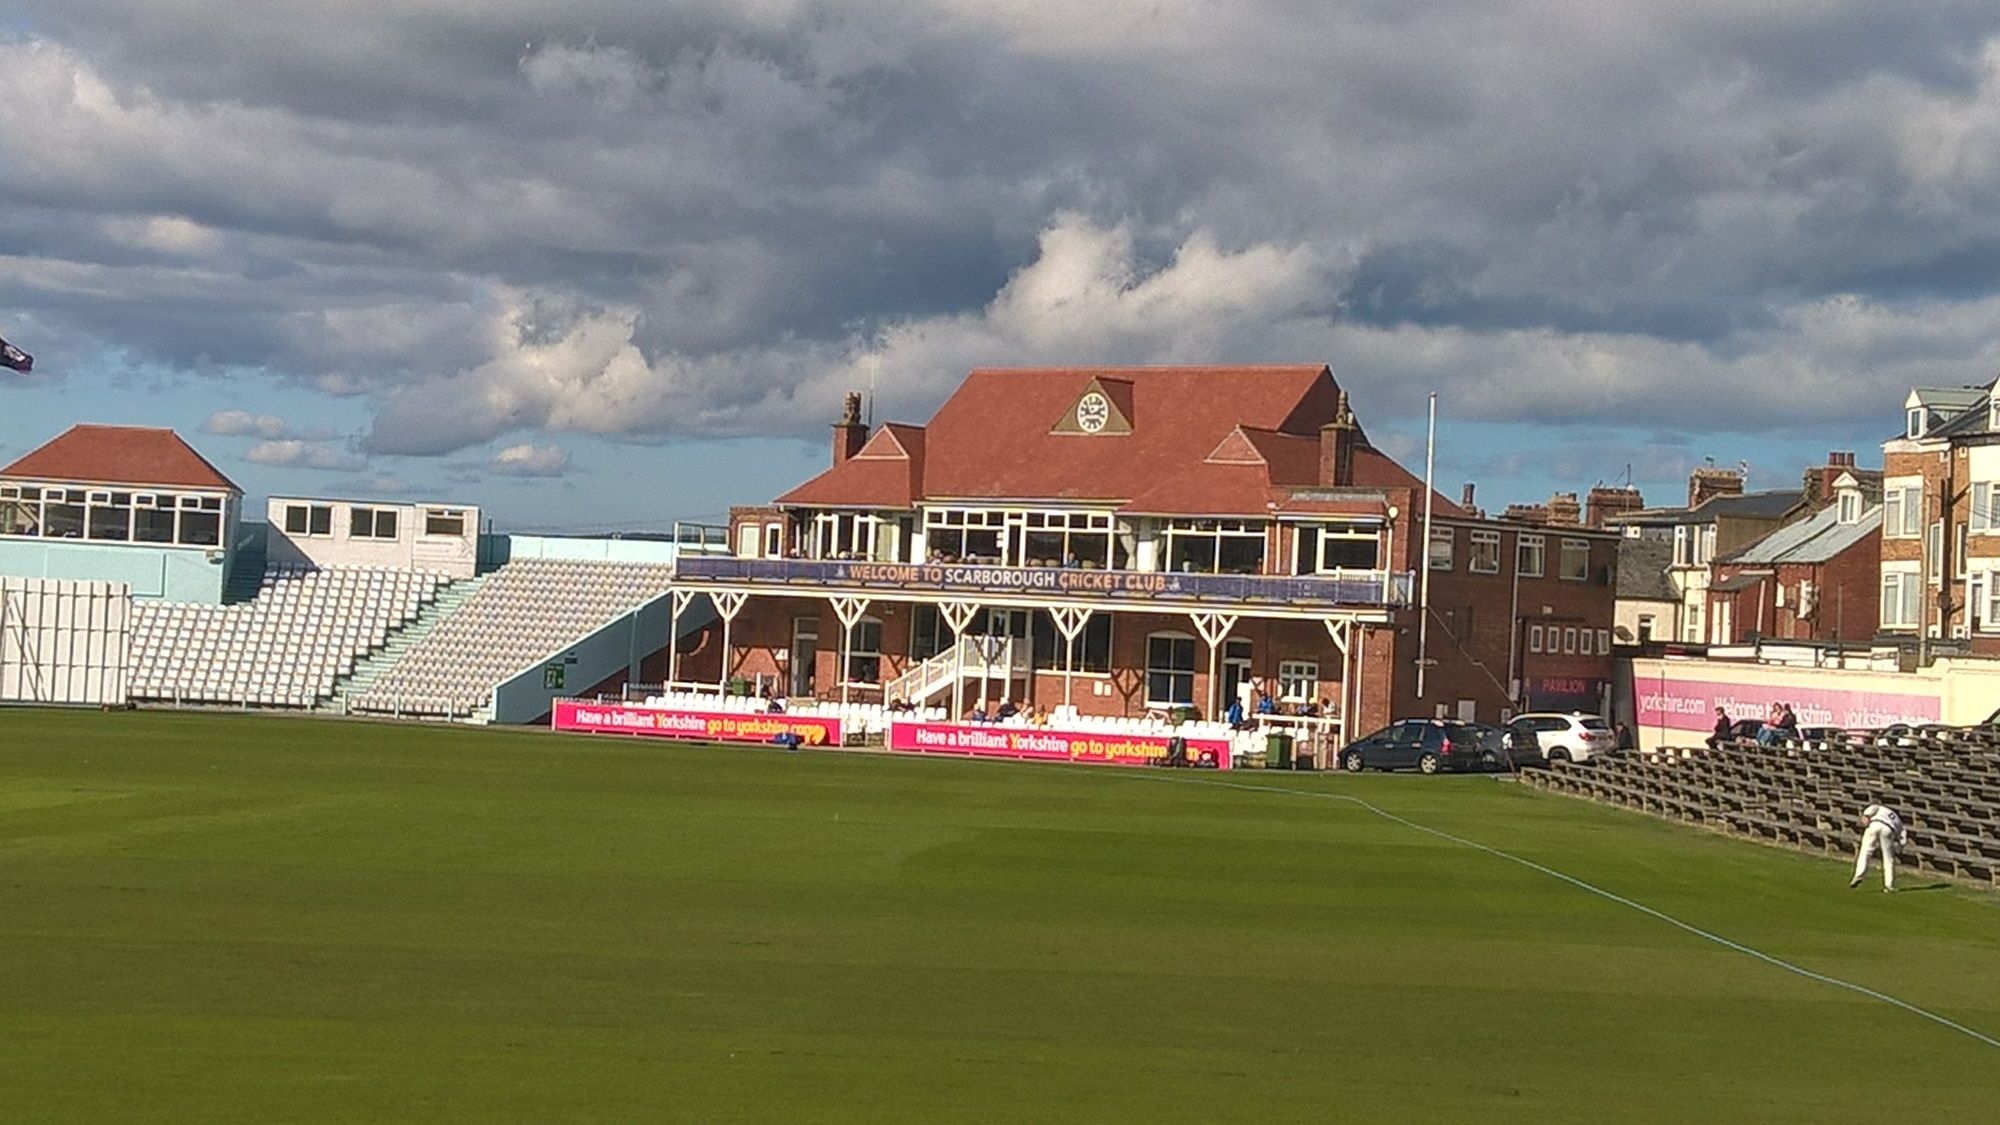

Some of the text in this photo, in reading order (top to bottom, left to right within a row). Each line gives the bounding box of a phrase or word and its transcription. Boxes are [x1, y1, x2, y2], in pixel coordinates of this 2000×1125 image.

[850, 565, 1166, 591] WELCOME TO SCARBOROUGH CRICKET CLUB
[1542, 679, 1586, 693] PAVILION
[1640, 692, 1706, 714] yorkshire.com
[1714, 696, 1764, 720] Welcome
[576, 709, 603, 725] Have
[604, 713, 611, 725] a
[611, 710, 654, 728] brilliant
[656, 713, 706, 731] Yorkshire
[707, 719, 721, 735] go
[723, 719, 736, 732] to
[916, 729, 945, 744] Have
[947, 734, 956, 746] a
[958, 731, 1008, 749] brilliant
[1010, 733, 1069, 753] Yorkshire
[1070, 740, 1087, 757] go
[1089, 739, 1104, 754] to
